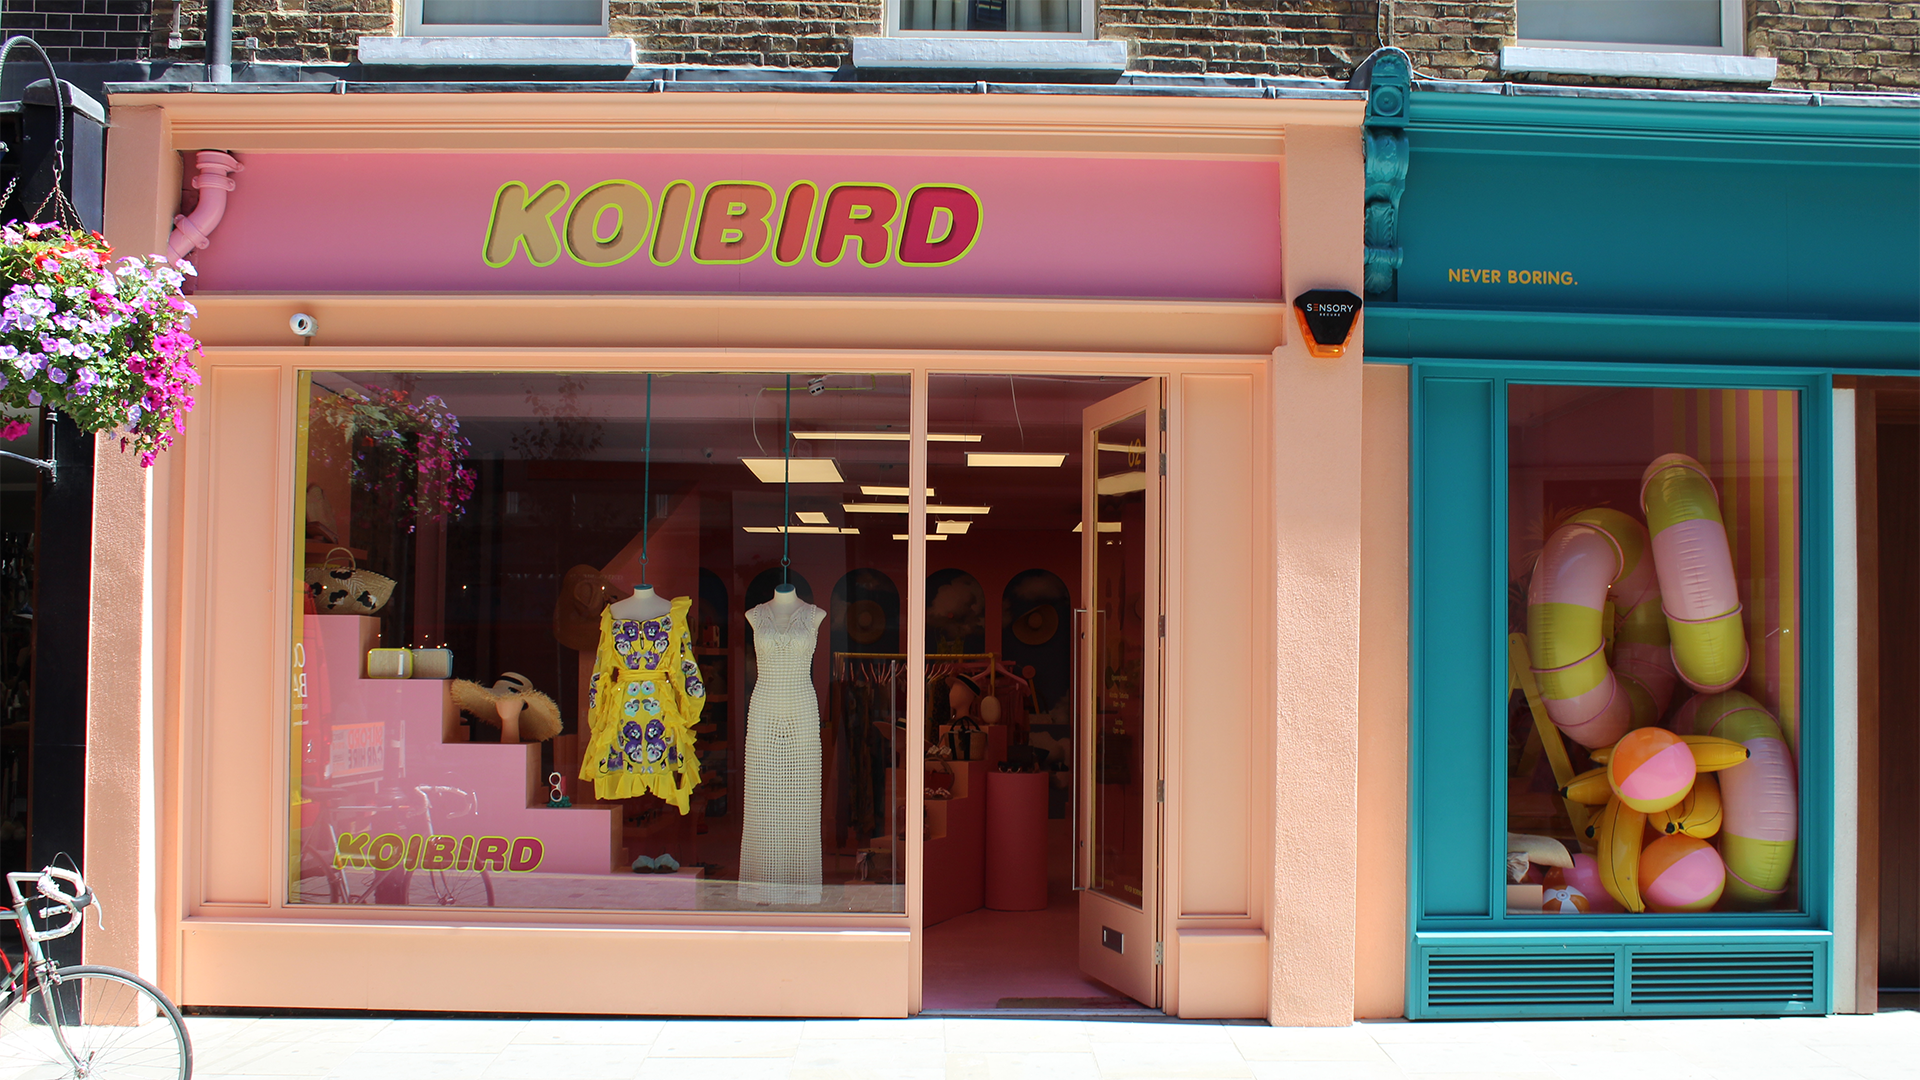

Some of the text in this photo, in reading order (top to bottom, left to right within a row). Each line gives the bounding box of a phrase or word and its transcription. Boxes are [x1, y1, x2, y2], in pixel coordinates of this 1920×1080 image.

[481, 178, 984, 269] KOIBIRD
[1448, 268, 1579, 285] NEVER BORING.
[1306, 303, 1354, 313] SENSORY
[333, 832, 545, 873] KOIBIRD
